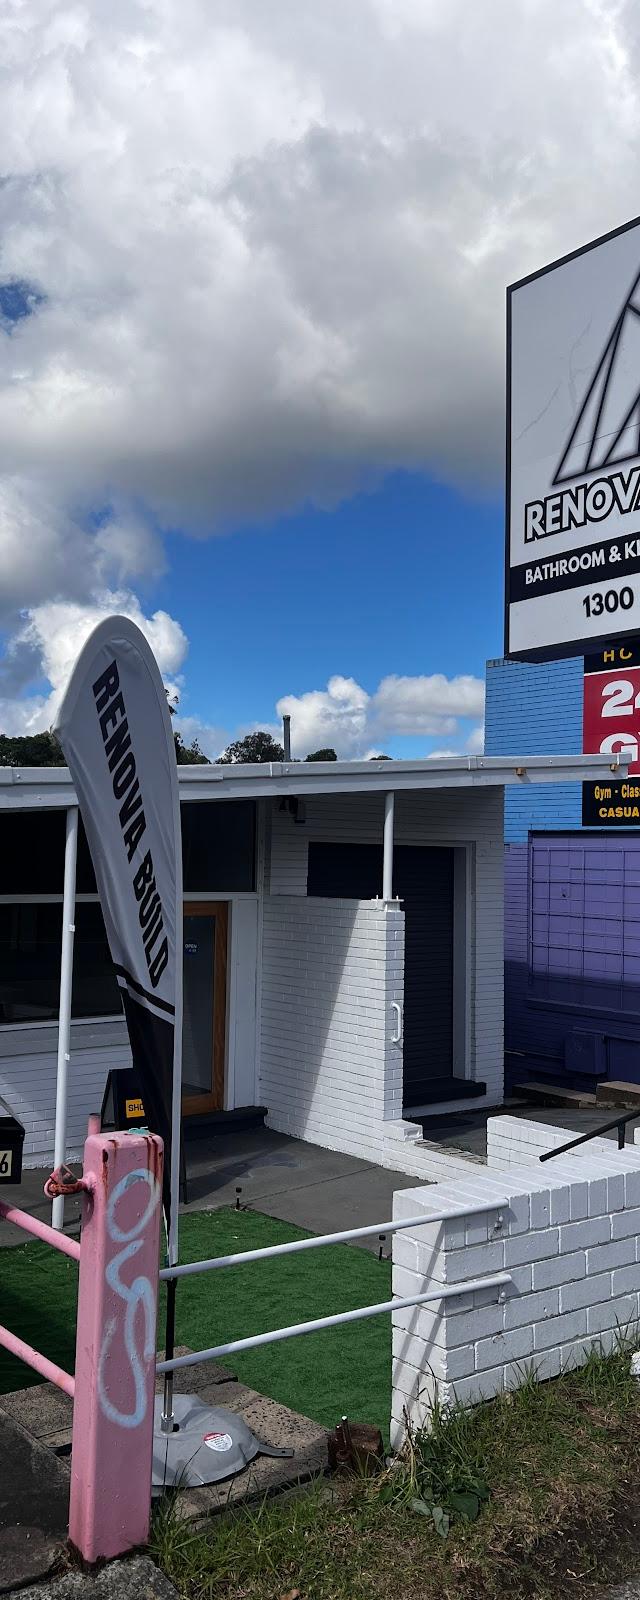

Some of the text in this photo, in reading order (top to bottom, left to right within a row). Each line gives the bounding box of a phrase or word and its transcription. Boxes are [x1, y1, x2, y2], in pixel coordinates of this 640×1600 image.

[525, 549, 605, 585] BATHROOM
[608, 545, 622, 563] &
[582, 586, 634, 617] 1300
[601, 680, 640, 717] 2
[594, 785, 612, 801] Gym
[92, 659, 168, 989] RENOVA BUILD
[0, 1153, 8, 1174] 6
